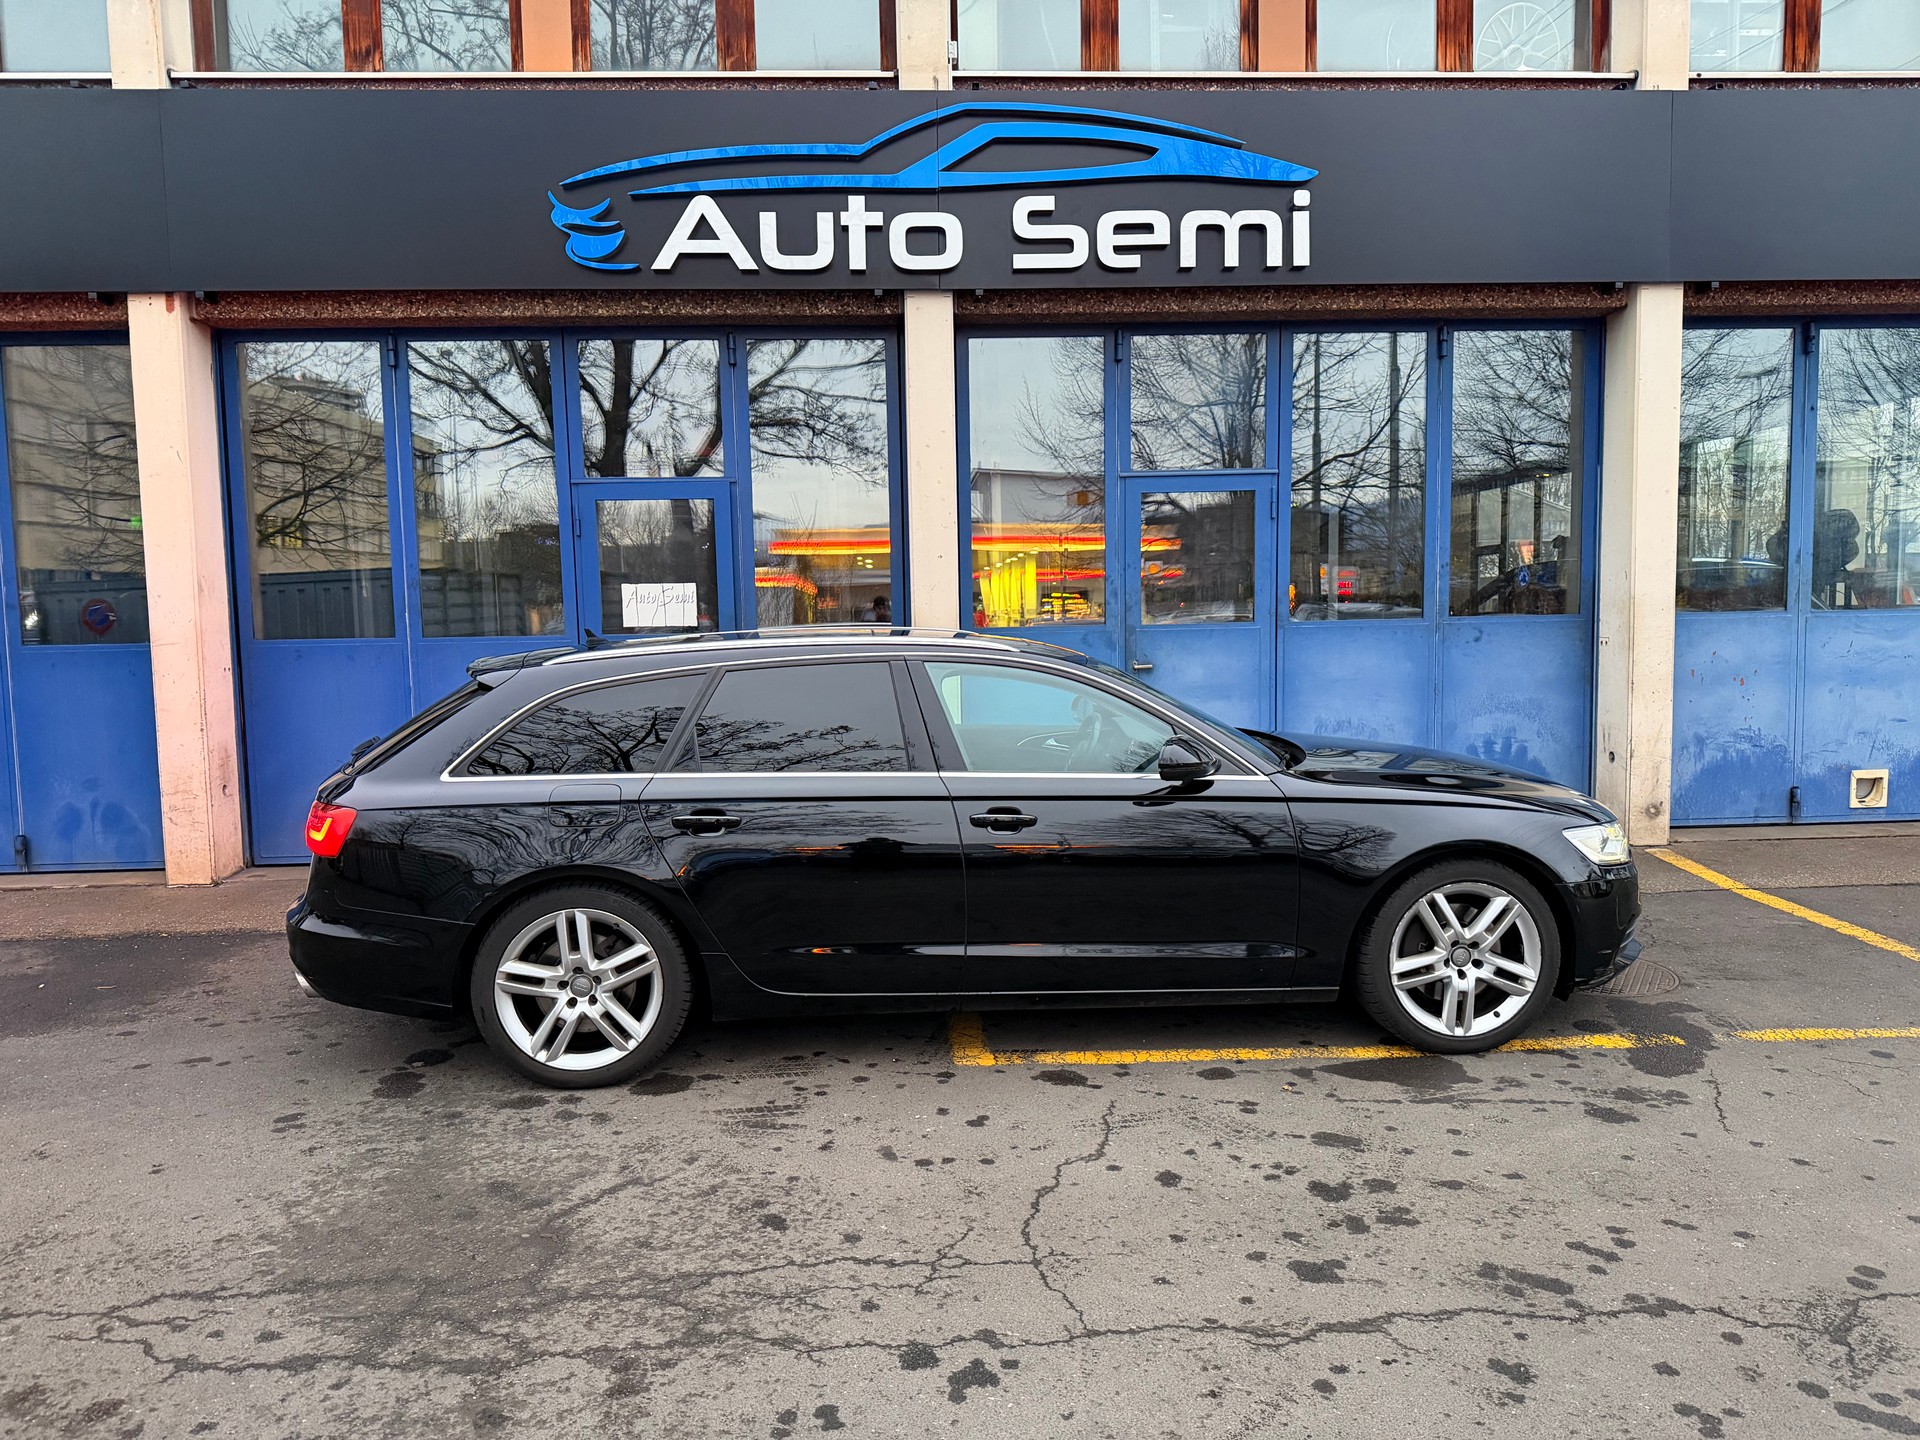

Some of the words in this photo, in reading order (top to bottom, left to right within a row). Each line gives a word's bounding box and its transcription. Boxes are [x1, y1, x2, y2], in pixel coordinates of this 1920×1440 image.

[650, 194, 965, 271] Auto
[1012, 189, 1311, 270] Semi
[626, 586, 657, 608] Auto
[657, 586, 695, 608] Semi
